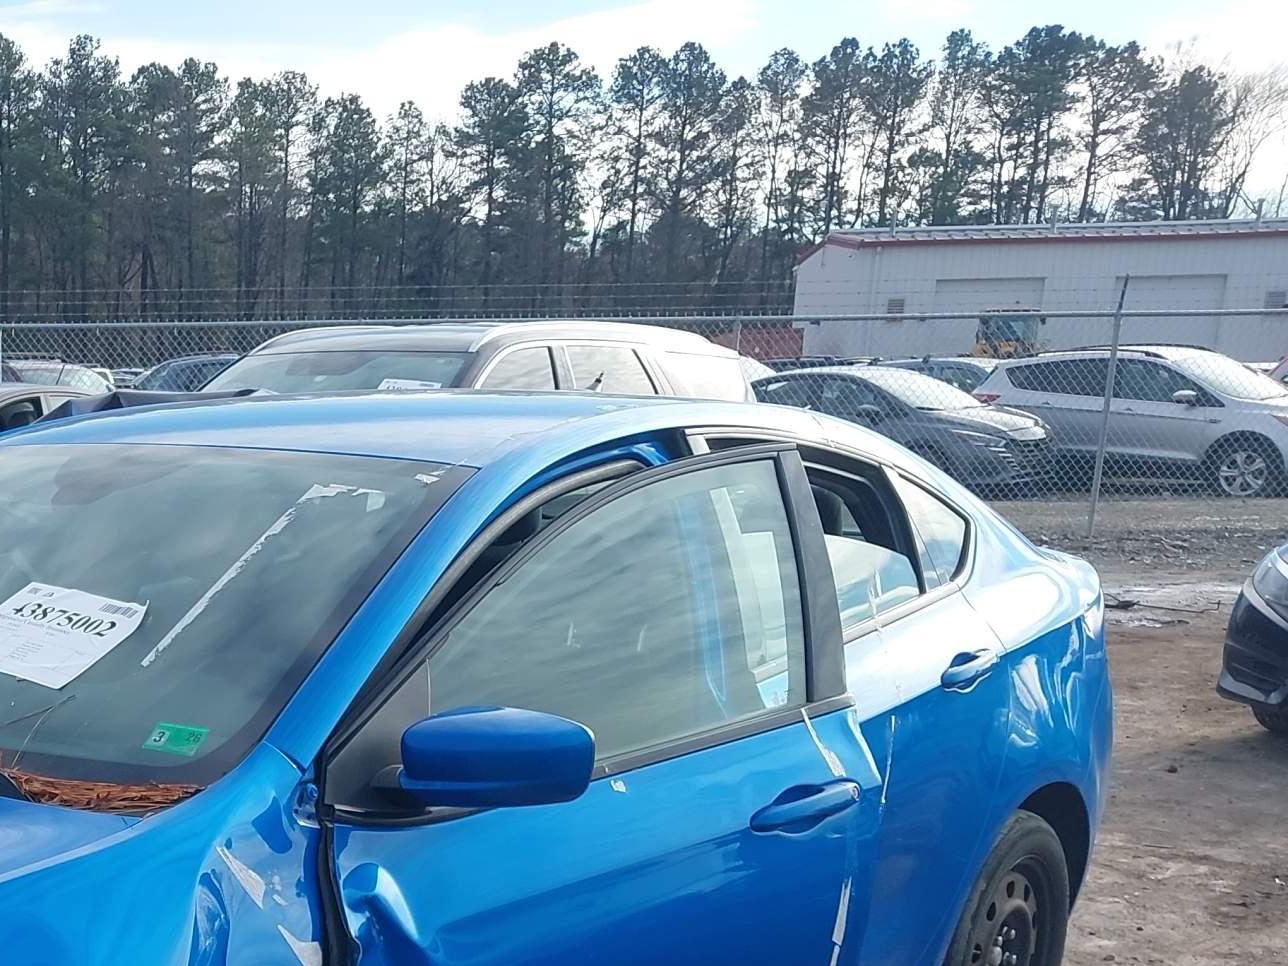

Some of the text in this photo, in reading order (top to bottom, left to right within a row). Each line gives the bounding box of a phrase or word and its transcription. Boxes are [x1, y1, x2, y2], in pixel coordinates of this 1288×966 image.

[12, 601, 118, 637] 43875002
[152, 730, 202, 744] 3 26
